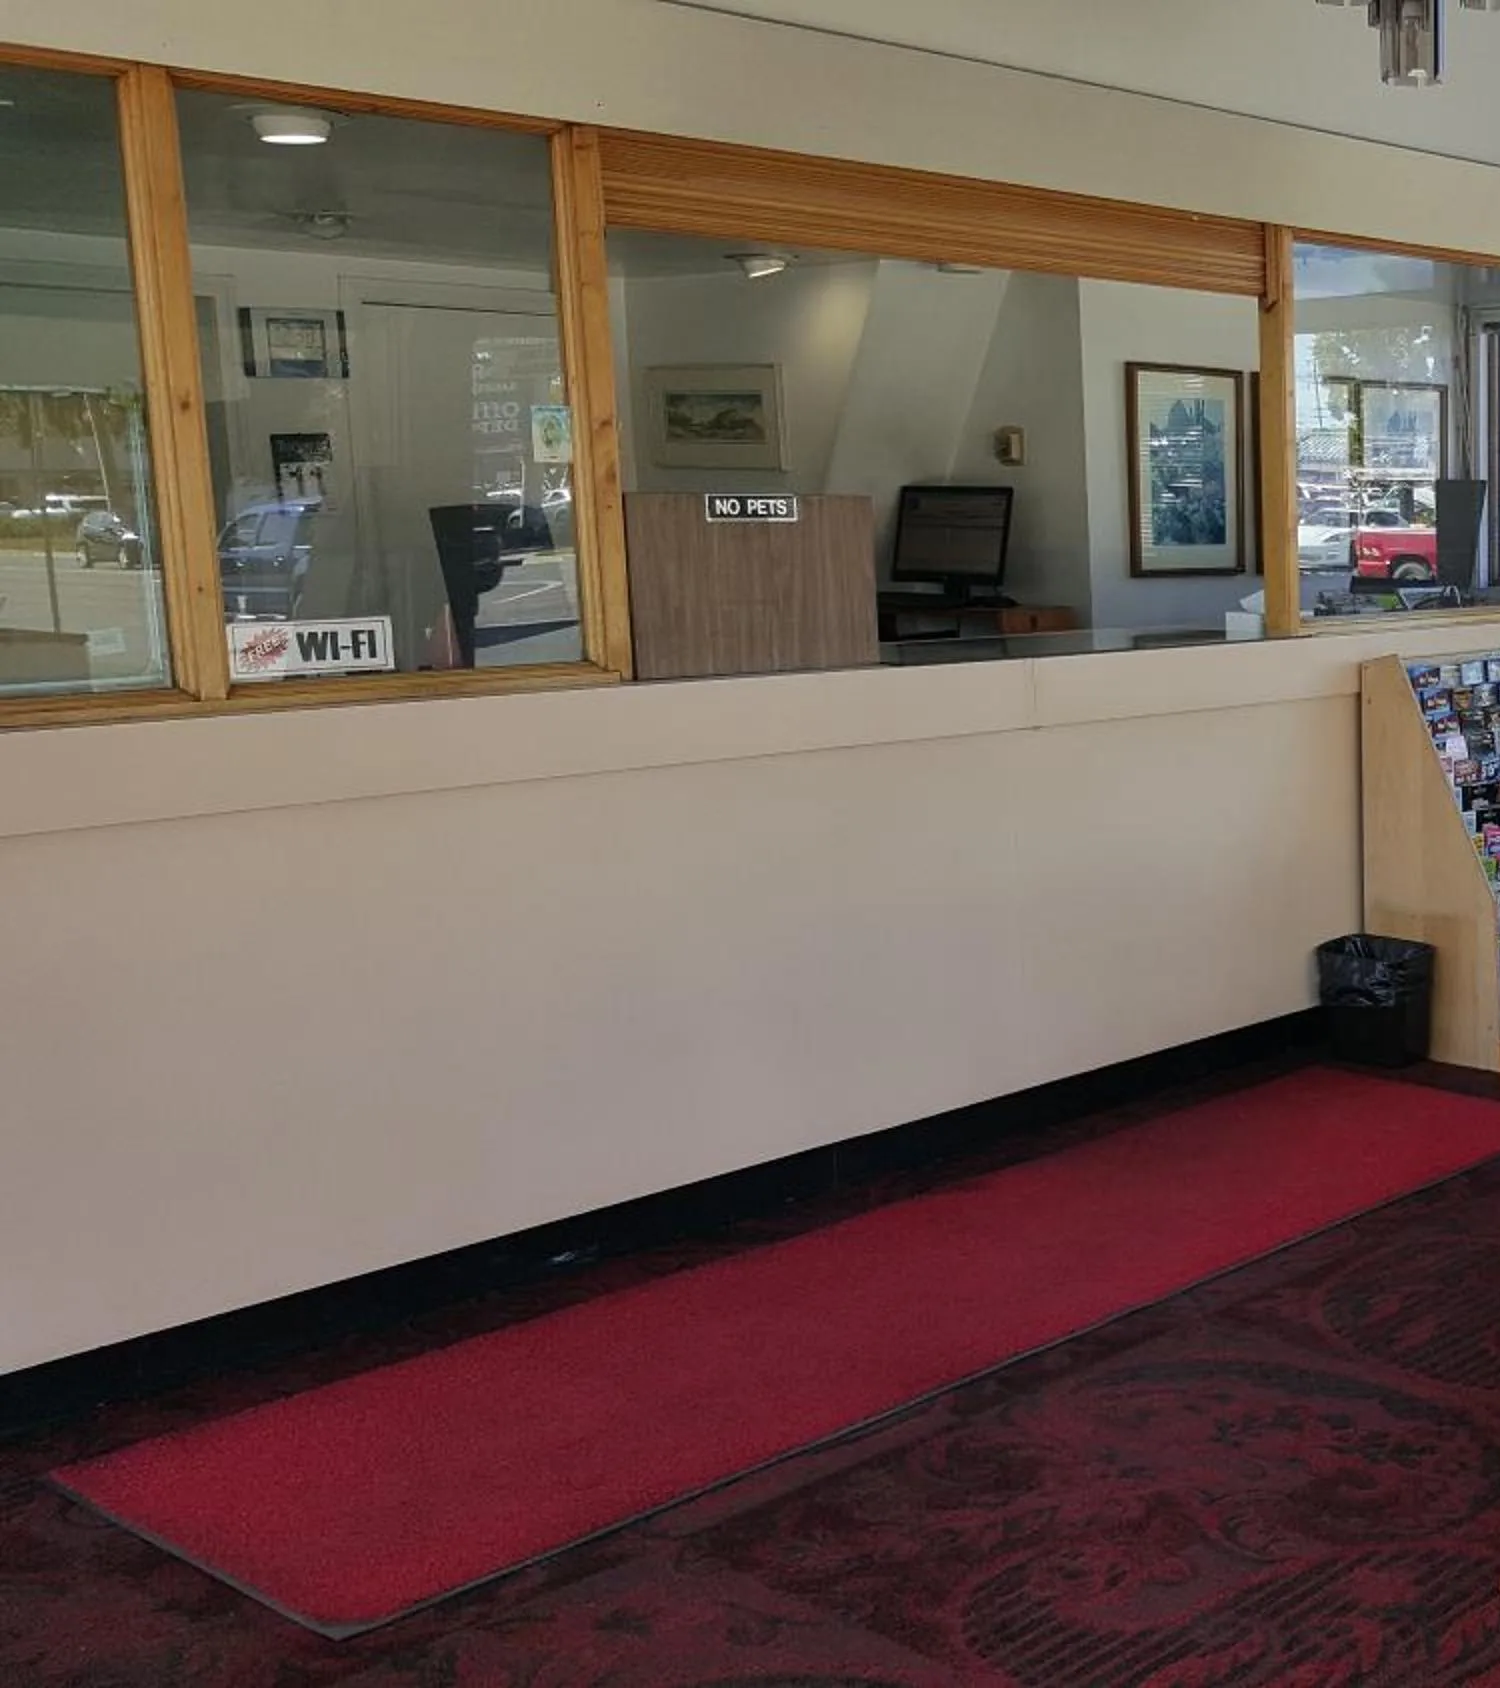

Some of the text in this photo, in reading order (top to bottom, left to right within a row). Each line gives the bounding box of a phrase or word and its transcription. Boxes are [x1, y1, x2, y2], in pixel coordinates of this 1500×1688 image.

[715, 499, 787, 515] NO PETS
[296, 630, 377, 662] WI-FI
